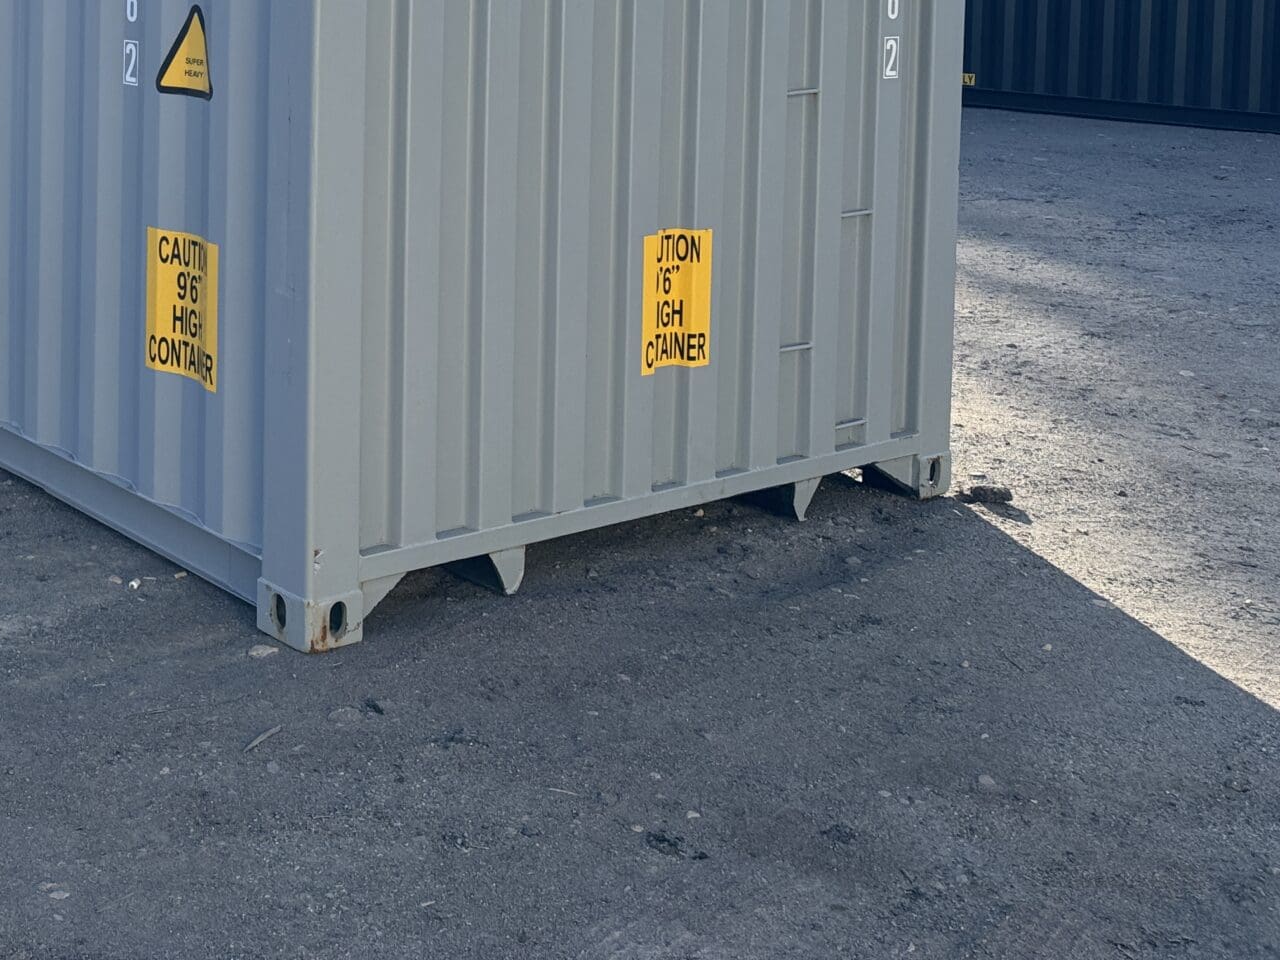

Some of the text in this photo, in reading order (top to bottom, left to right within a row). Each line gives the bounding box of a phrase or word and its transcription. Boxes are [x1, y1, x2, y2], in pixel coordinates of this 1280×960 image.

[184, 69, 205, 79] HEAVY
[185, 57, 205, 67] SUPER
[656, 234, 701, 264] UTION
[656, 299, 684, 329] IGH
[645, 332, 706, 369] CTAINER
